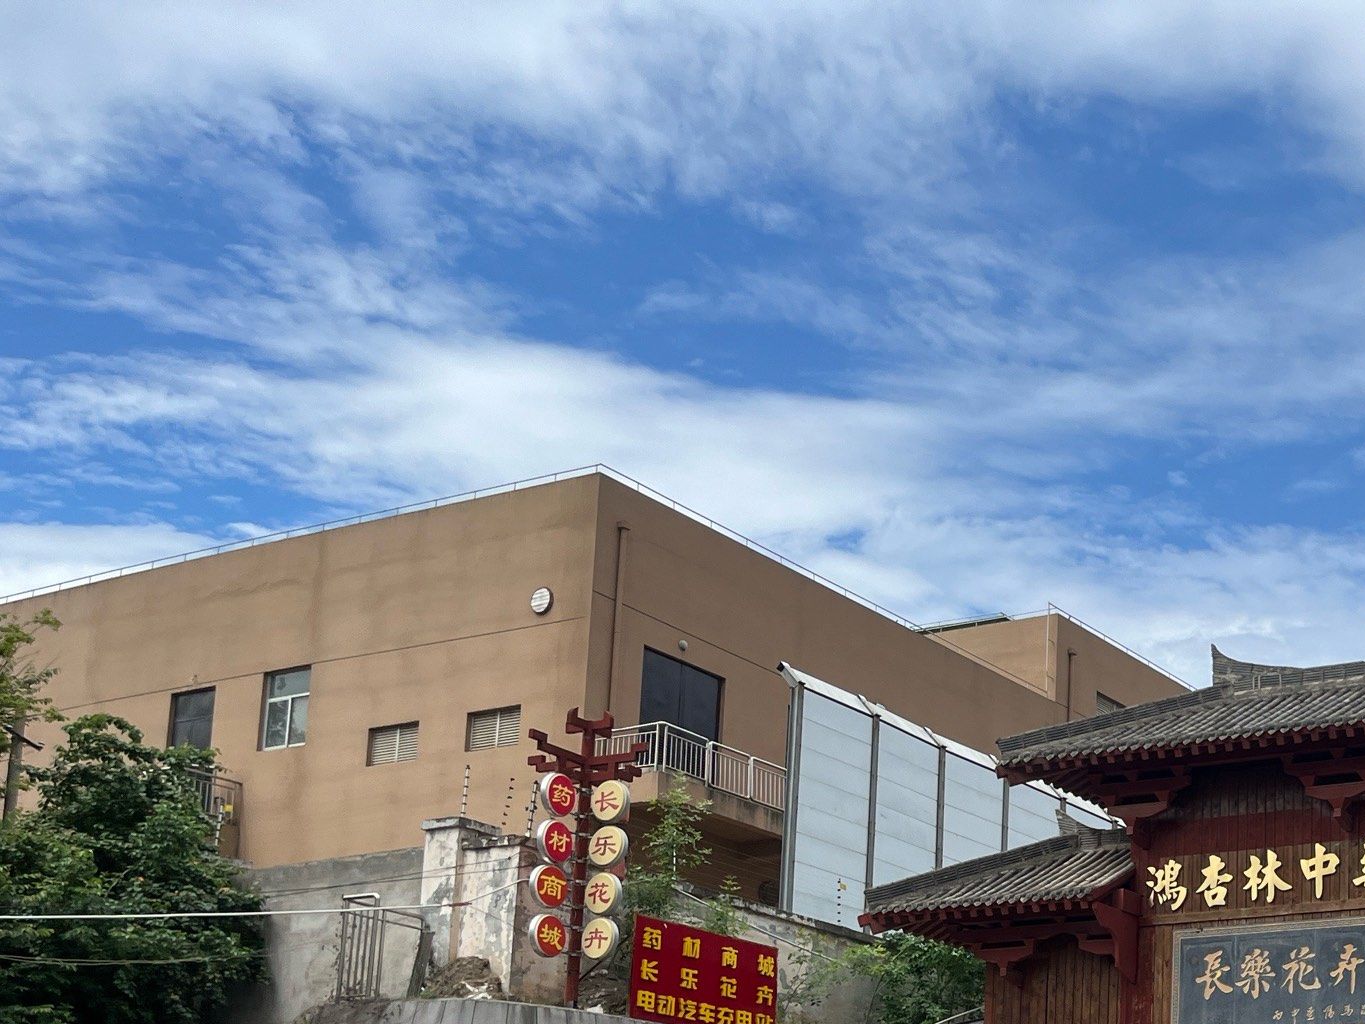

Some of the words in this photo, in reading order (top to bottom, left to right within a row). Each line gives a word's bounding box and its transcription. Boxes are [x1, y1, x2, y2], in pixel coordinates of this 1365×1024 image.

[539, 783, 574, 951] 药材商城
[584, 790, 620, 950] 长乐花卉
[639, 958, 775, 1007] 长乐花卉
[641, 926, 776, 978] 药材商城
